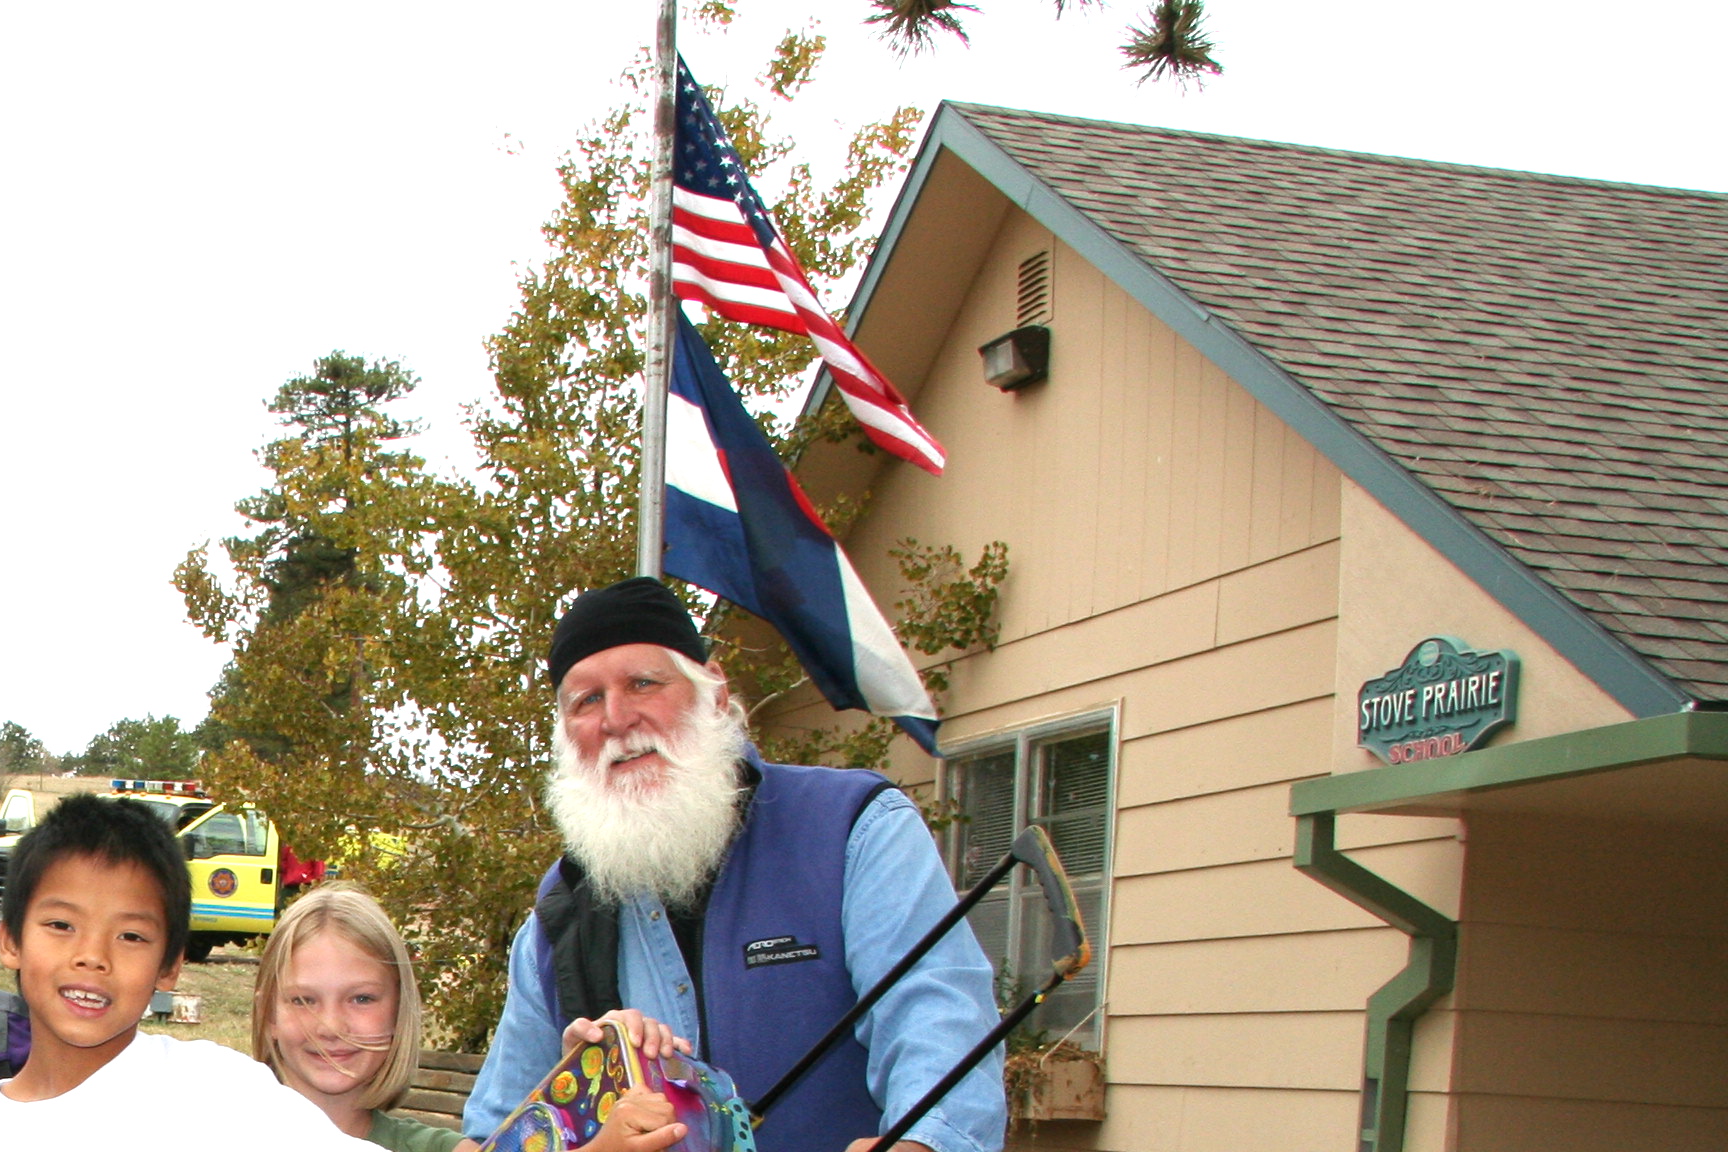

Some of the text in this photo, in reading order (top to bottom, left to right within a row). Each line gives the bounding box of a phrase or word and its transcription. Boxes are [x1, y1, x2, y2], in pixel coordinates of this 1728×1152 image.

[1360, 671, 1500, 730] STOVE PRAIRIE
[1388, 733, 1466, 764] SCHOOL
